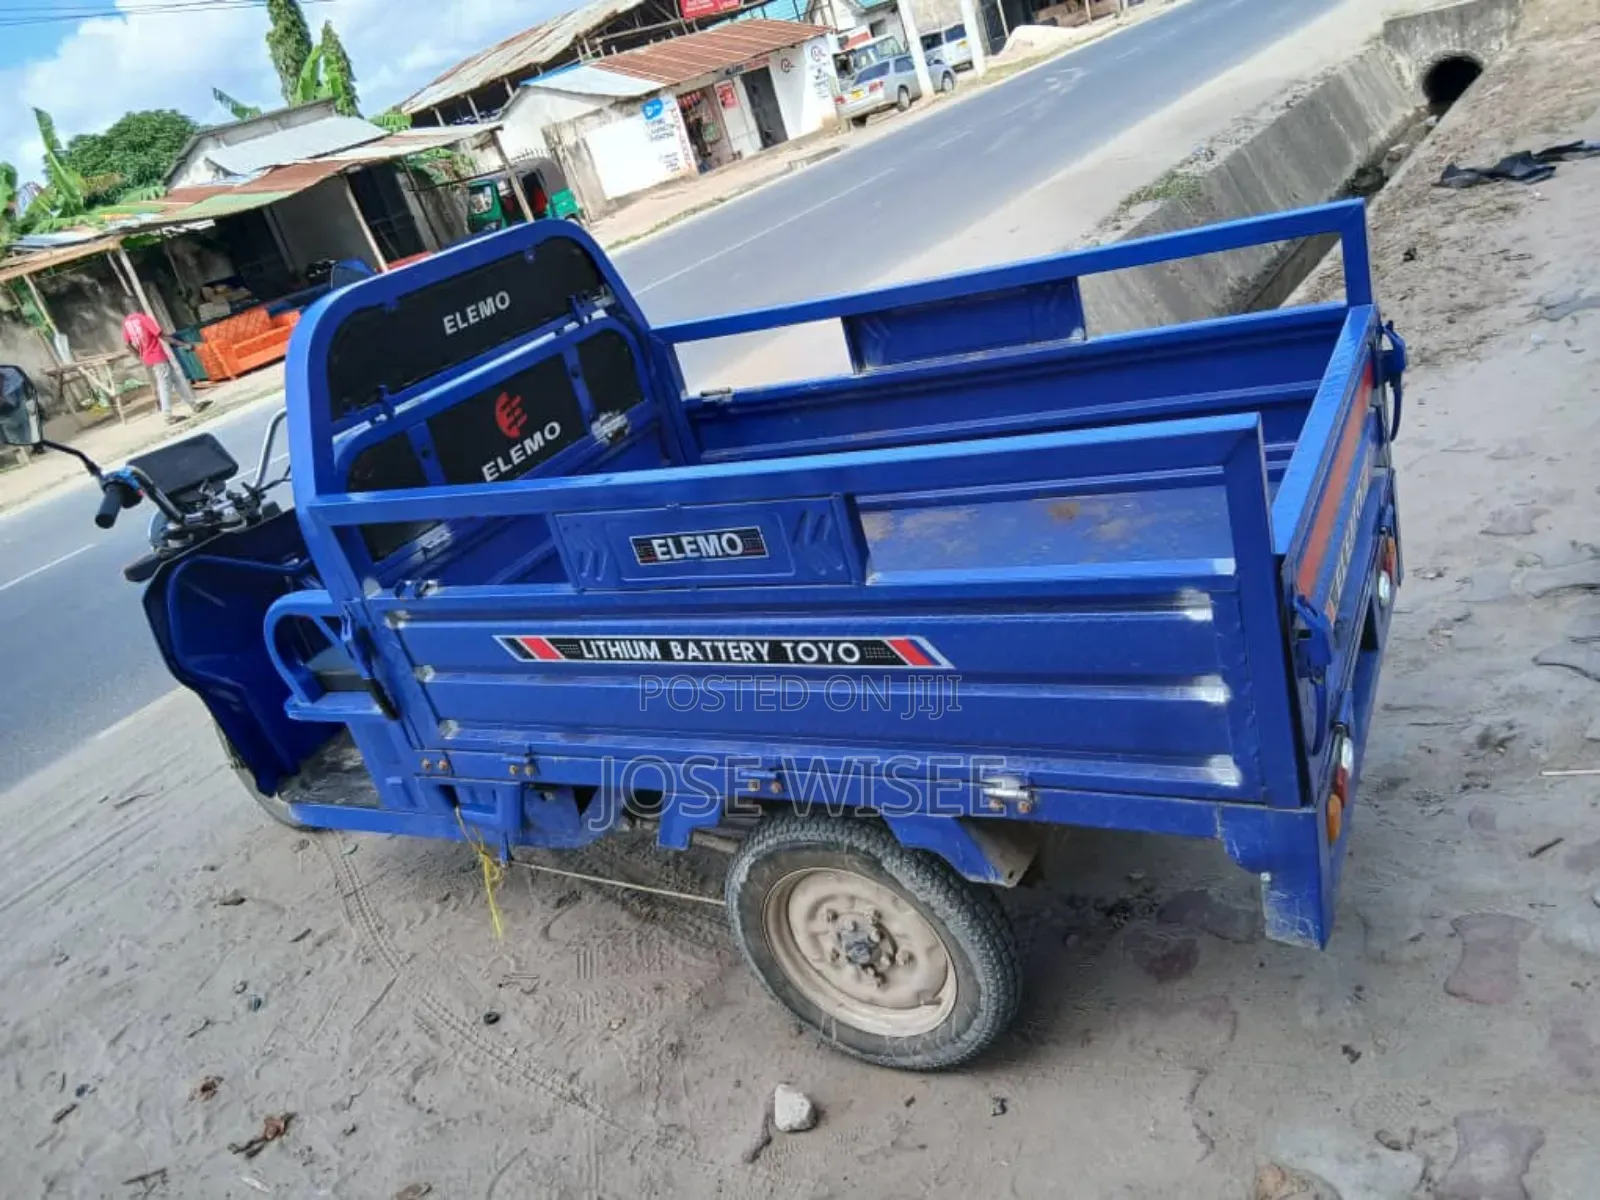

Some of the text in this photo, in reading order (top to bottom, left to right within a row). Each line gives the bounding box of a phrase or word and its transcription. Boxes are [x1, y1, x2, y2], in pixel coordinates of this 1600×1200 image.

[443, 291, 511, 335] ELEMO
[482, 421, 561, 482] ELEMO
[653, 532, 744, 561] ELEMO
[580, 640, 863, 664] LITHIUM BATTERY TOYO
